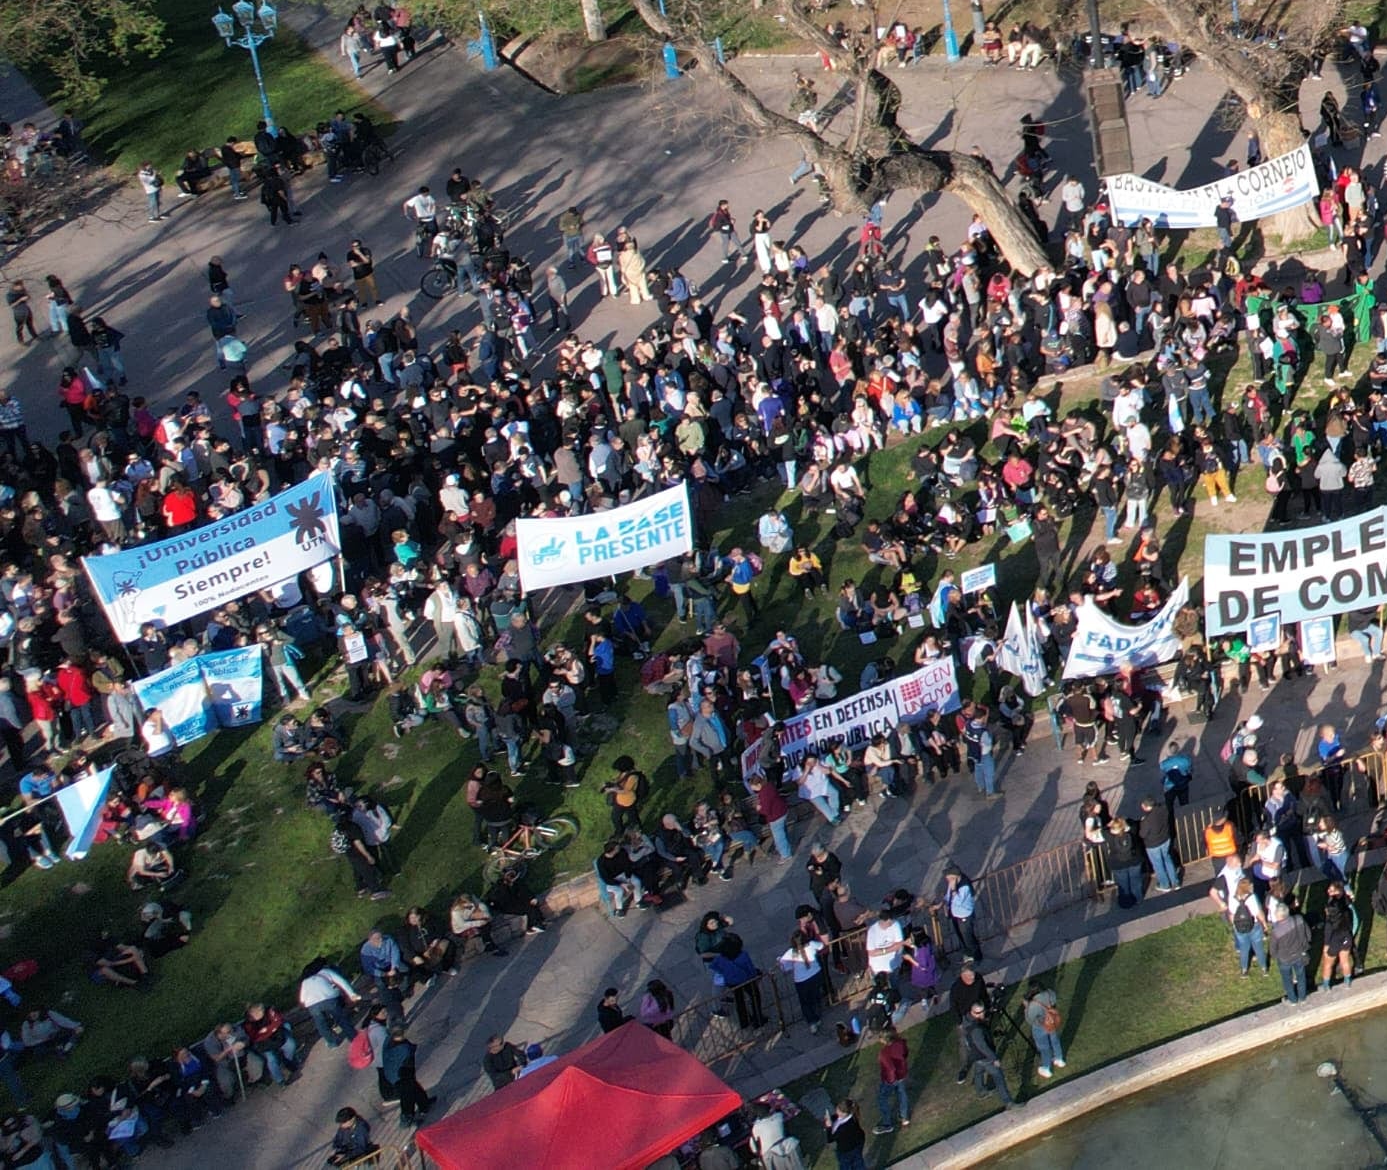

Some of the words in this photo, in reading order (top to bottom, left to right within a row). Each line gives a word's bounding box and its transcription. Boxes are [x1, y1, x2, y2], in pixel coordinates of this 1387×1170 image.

[1237, 149, 1306, 196] CORNEJO
[137, 501, 278, 570] ¡Universidad
[575, 525, 611, 545] LA
[618, 501, 684, 536] BASE
[578, 518, 686, 566] PRESENTE
[173, 550, 272, 600] Siempre!
[175, 535, 257, 576] Pública
[1218, 584, 1280, 628] DE
[814, 711, 833, 730] EN
[835, 688, 893, 724] DEFENSA
